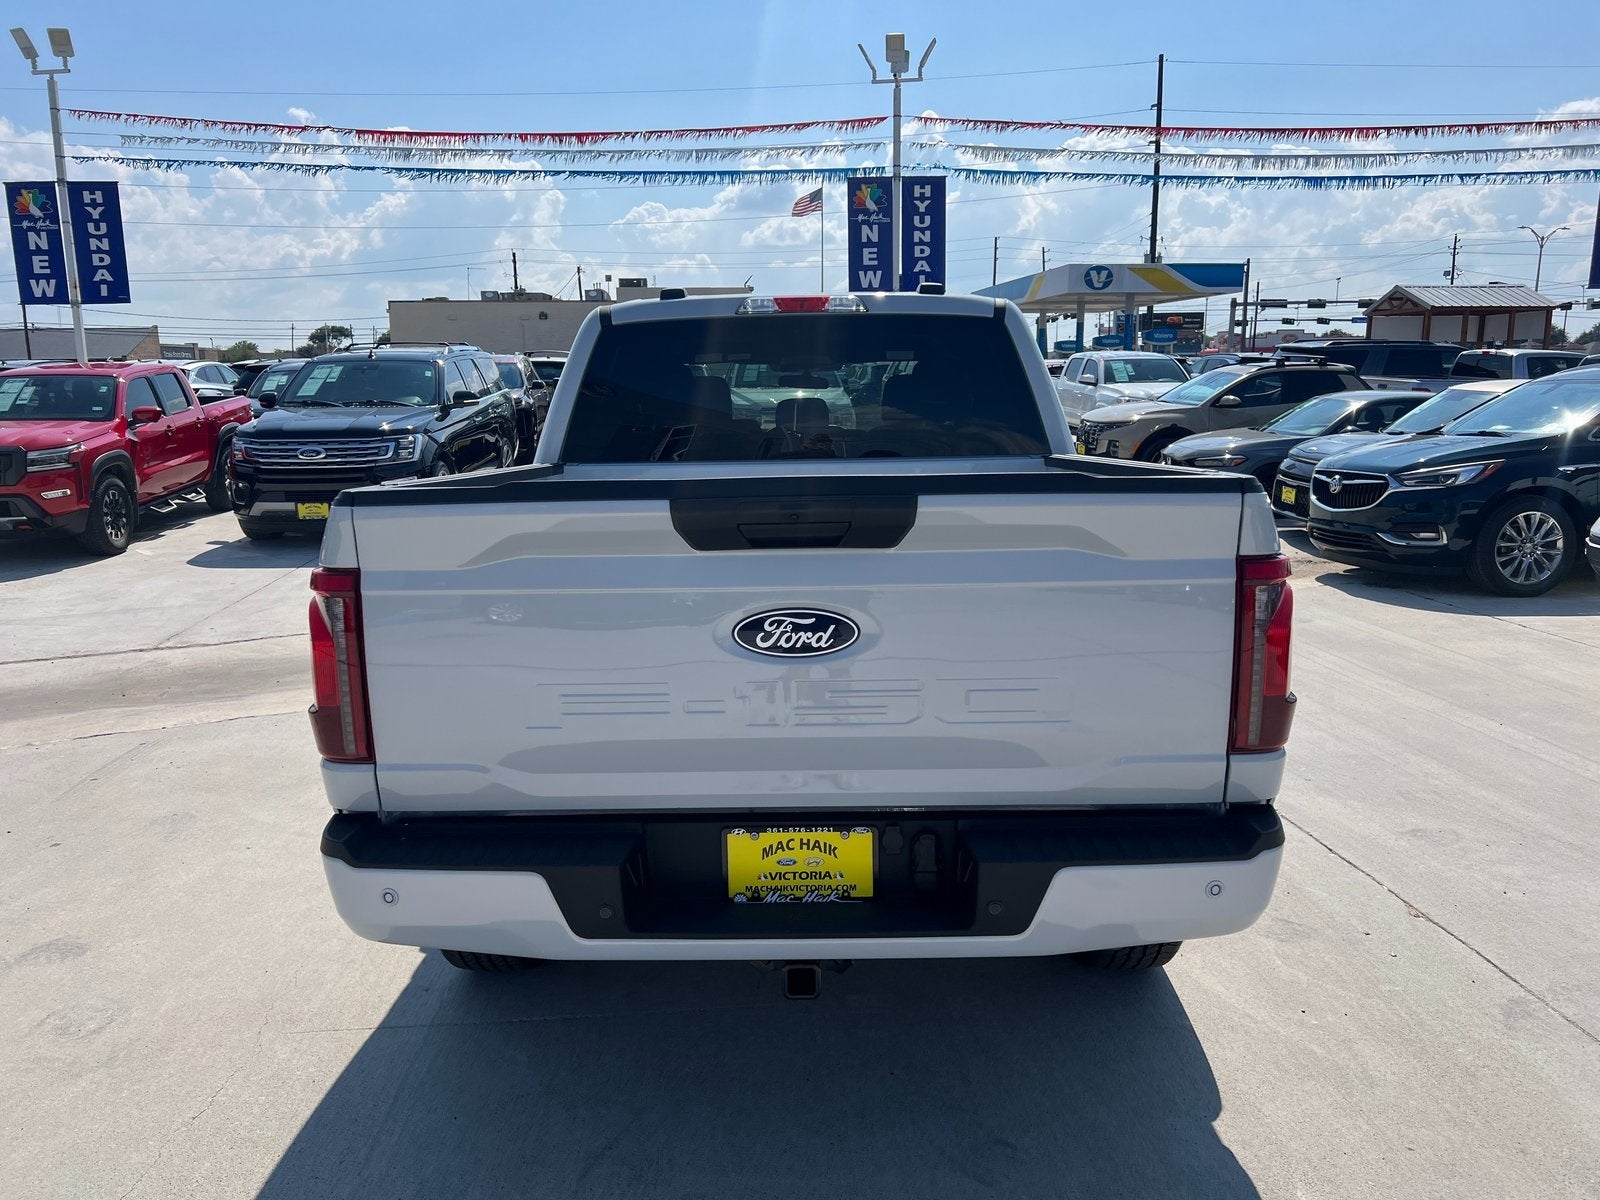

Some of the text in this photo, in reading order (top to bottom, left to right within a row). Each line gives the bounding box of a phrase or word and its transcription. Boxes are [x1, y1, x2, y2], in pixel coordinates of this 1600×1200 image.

[82, 190, 115, 297] HYUNDAI
[913, 184, 932, 283] HYUNDAI
[27, 231, 57, 298] NEW
[858, 224, 883, 289] NEW
[755, 616, 835, 650] Ford
[525, 677, 1073, 730] F-150
[761, 837, 839, 861] MAC HAIK
[744, 884, 857, 893] MACHAIKVICTORIACOM
[762, 890, 841, 904] Mac Haik
[768, 871, 833, 881] VICTORIA
